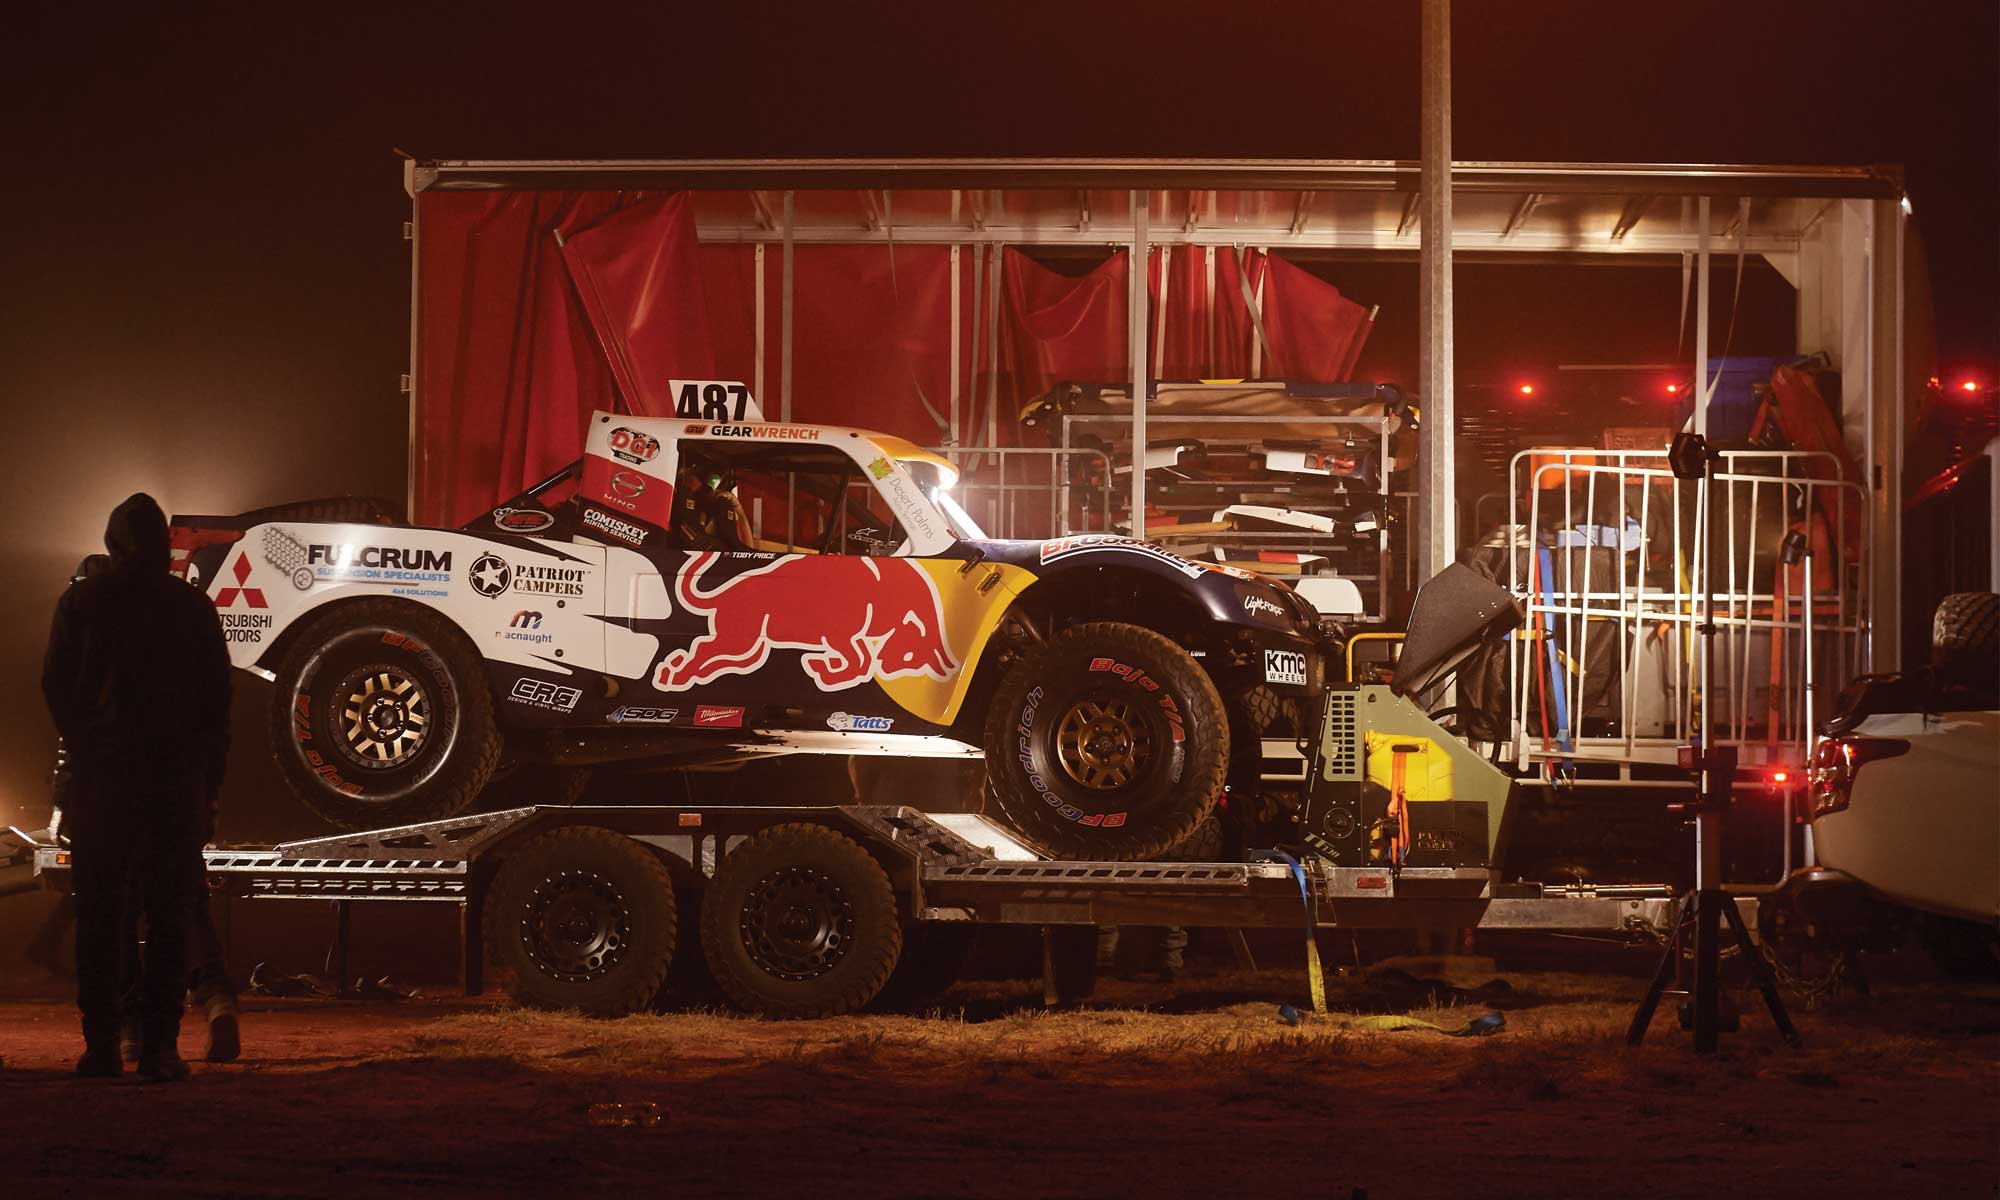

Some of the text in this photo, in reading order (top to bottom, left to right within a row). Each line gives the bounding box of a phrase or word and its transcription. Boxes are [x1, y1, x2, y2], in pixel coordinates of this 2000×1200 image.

[677, 384, 748, 422] 487
[711, 425, 819, 440] GEARWRENCH
[611, 430, 657, 459] DGI
[603, 493, 636, 511] HINO
[889, 478, 914, 509] Desert
[912, 508, 935, 540] Palms
[583, 508, 649, 540] COMISKEY
[583, 518, 642, 545] MINING SERVICES
[384, 571, 450, 582] SPECIALISTS
[515, 565, 585, 582] PATRIOT
[406, 588, 448, 597] SOLUTIONS
[513, 579, 584, 596] CAMPERS
[220, 614, 272, 628] TSUBISHI
[223, 629, 261, 642] OTORS
[1269, 673, 1305, 682] WHEELS
[512, 677, 580, 708] CRG
[1089, 657, 1186, 743] Baja T/A
[534, 702, 550, 710] VINYL
[552, 706, 571, 714] WRAPS
[700, 708, 739, 719] Milwaukee
[852, 716, 891, 729] Tatts
[1019, 686, 1128, 828] BFGoodrich
